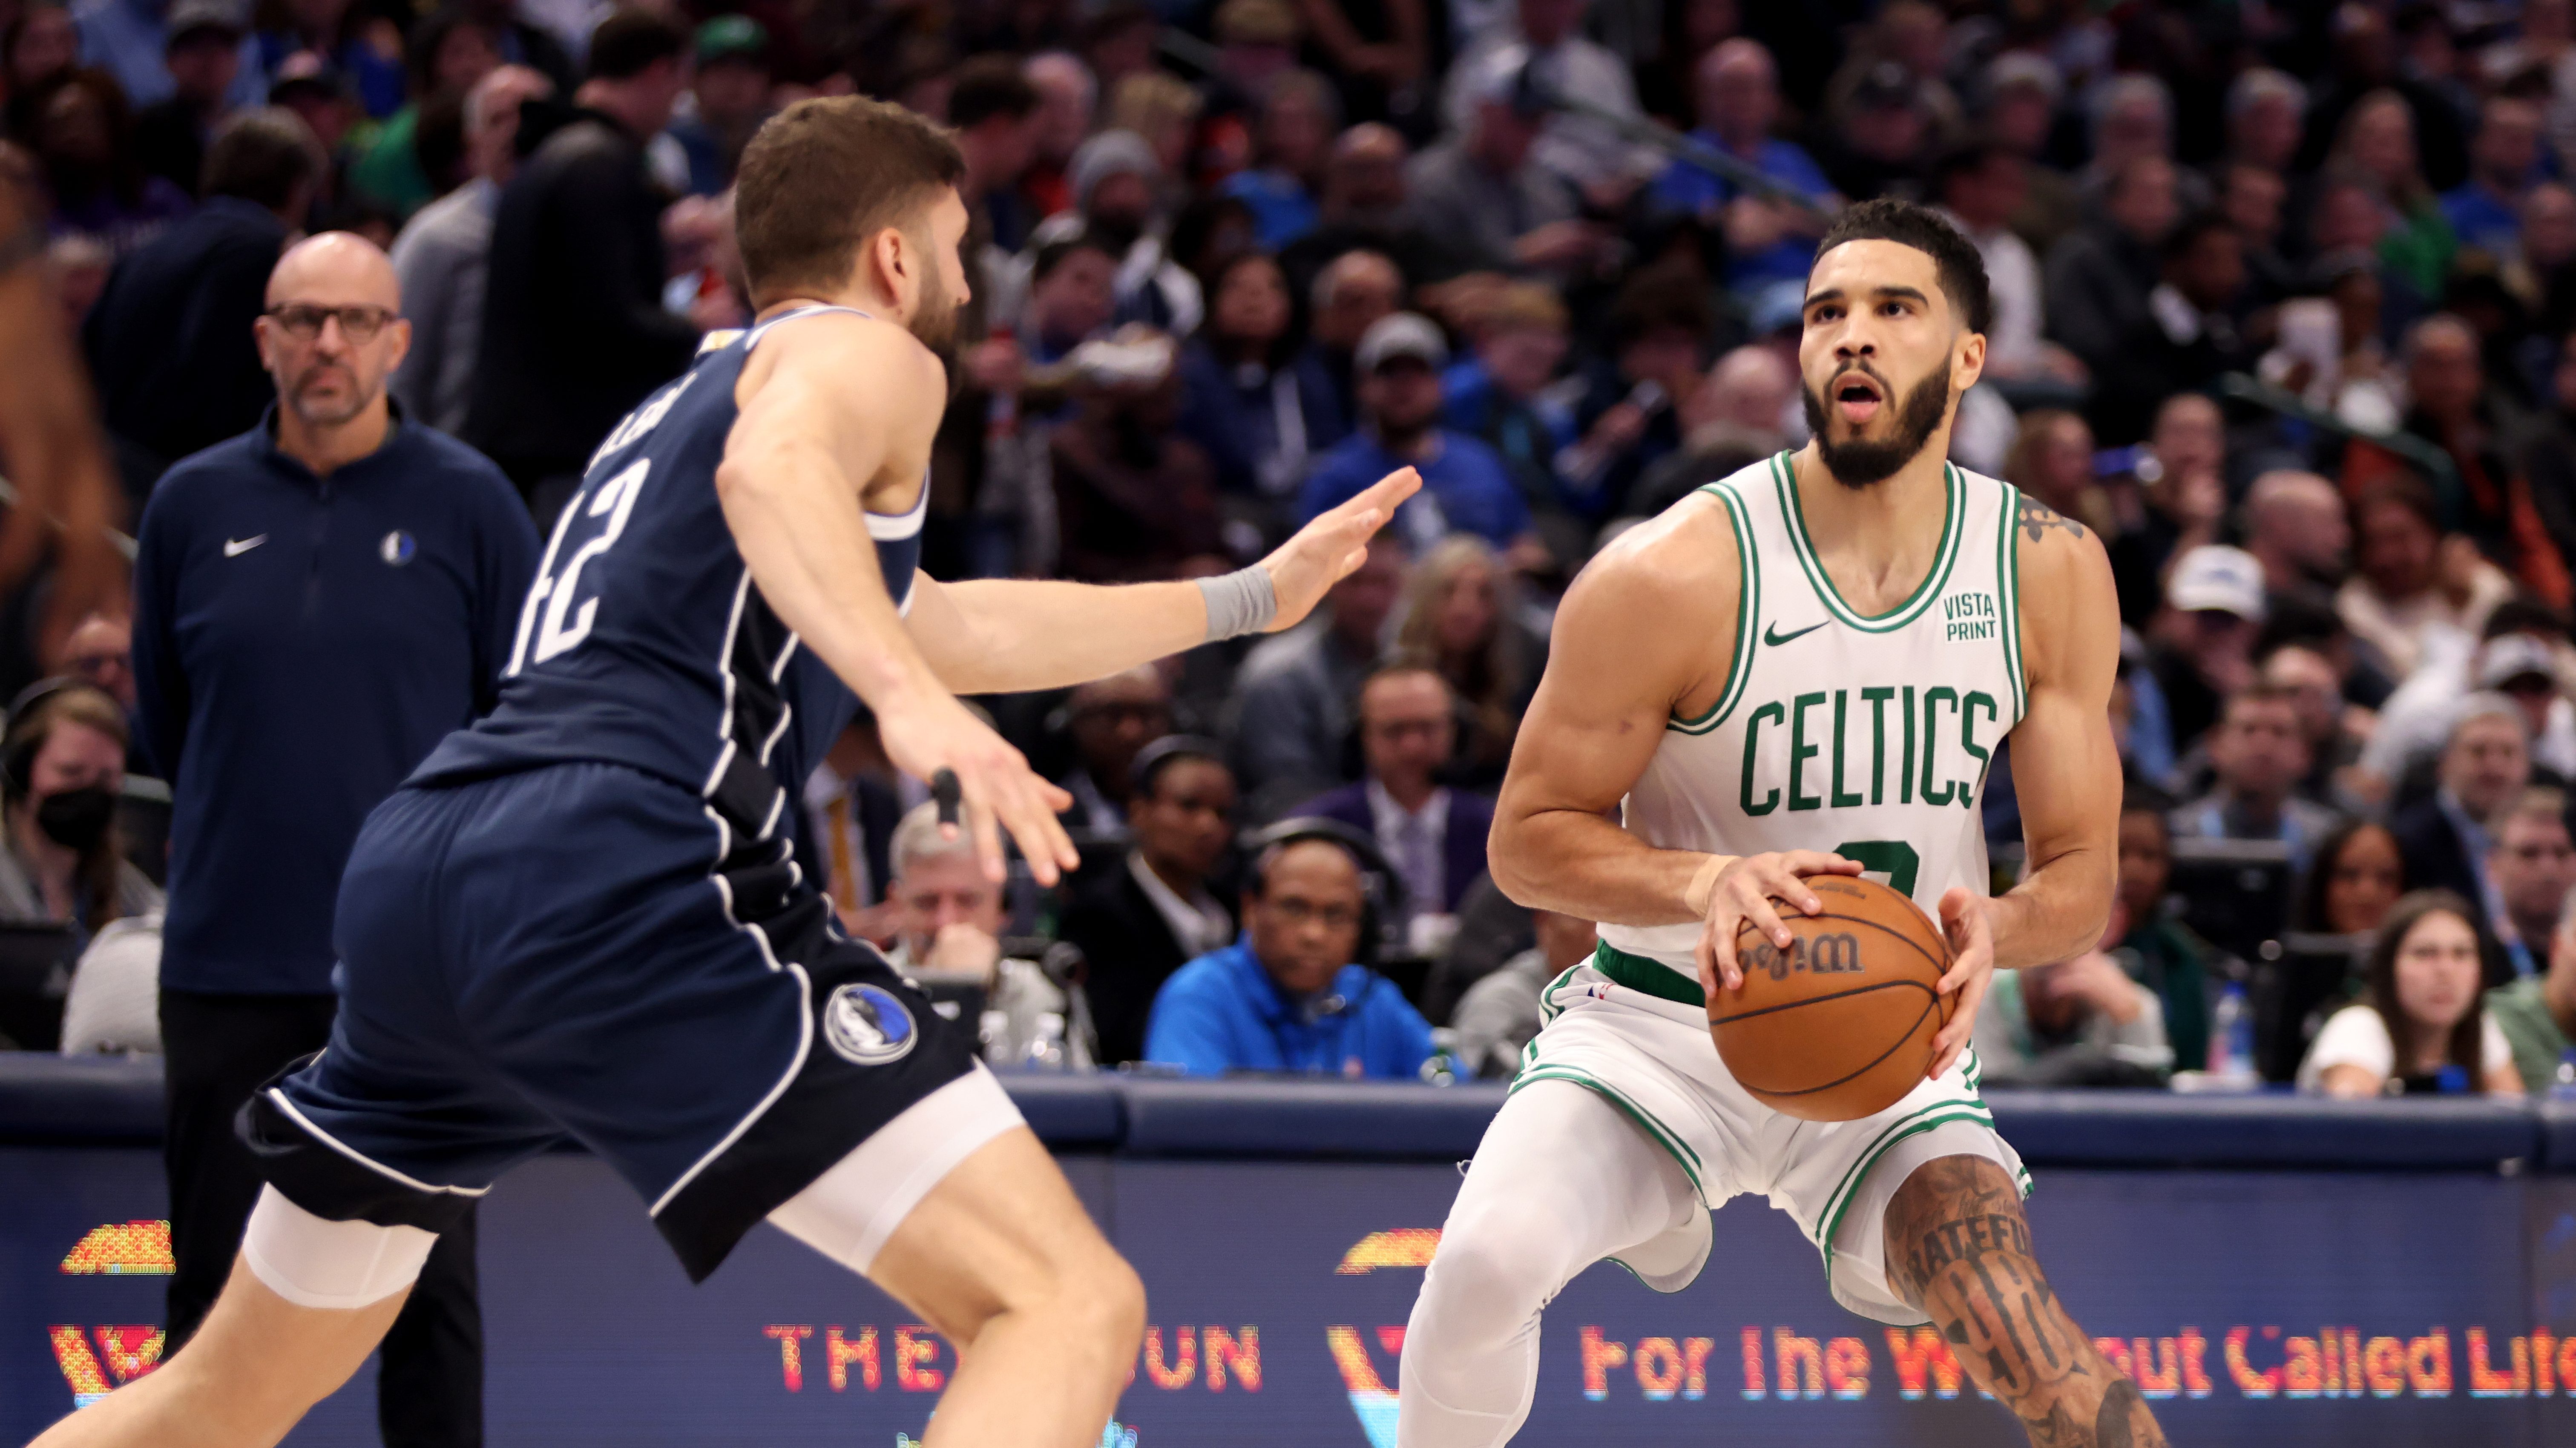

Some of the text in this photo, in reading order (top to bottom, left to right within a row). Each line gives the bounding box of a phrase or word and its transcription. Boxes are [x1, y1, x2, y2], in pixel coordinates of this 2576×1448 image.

[1944, 593, 1995, 620] VISTA
[1947, 620, 1996, 641] PRINT
[1740, 685, 1997, 817] CELTICS
[1733, 932, 1866, 982] Wilso
